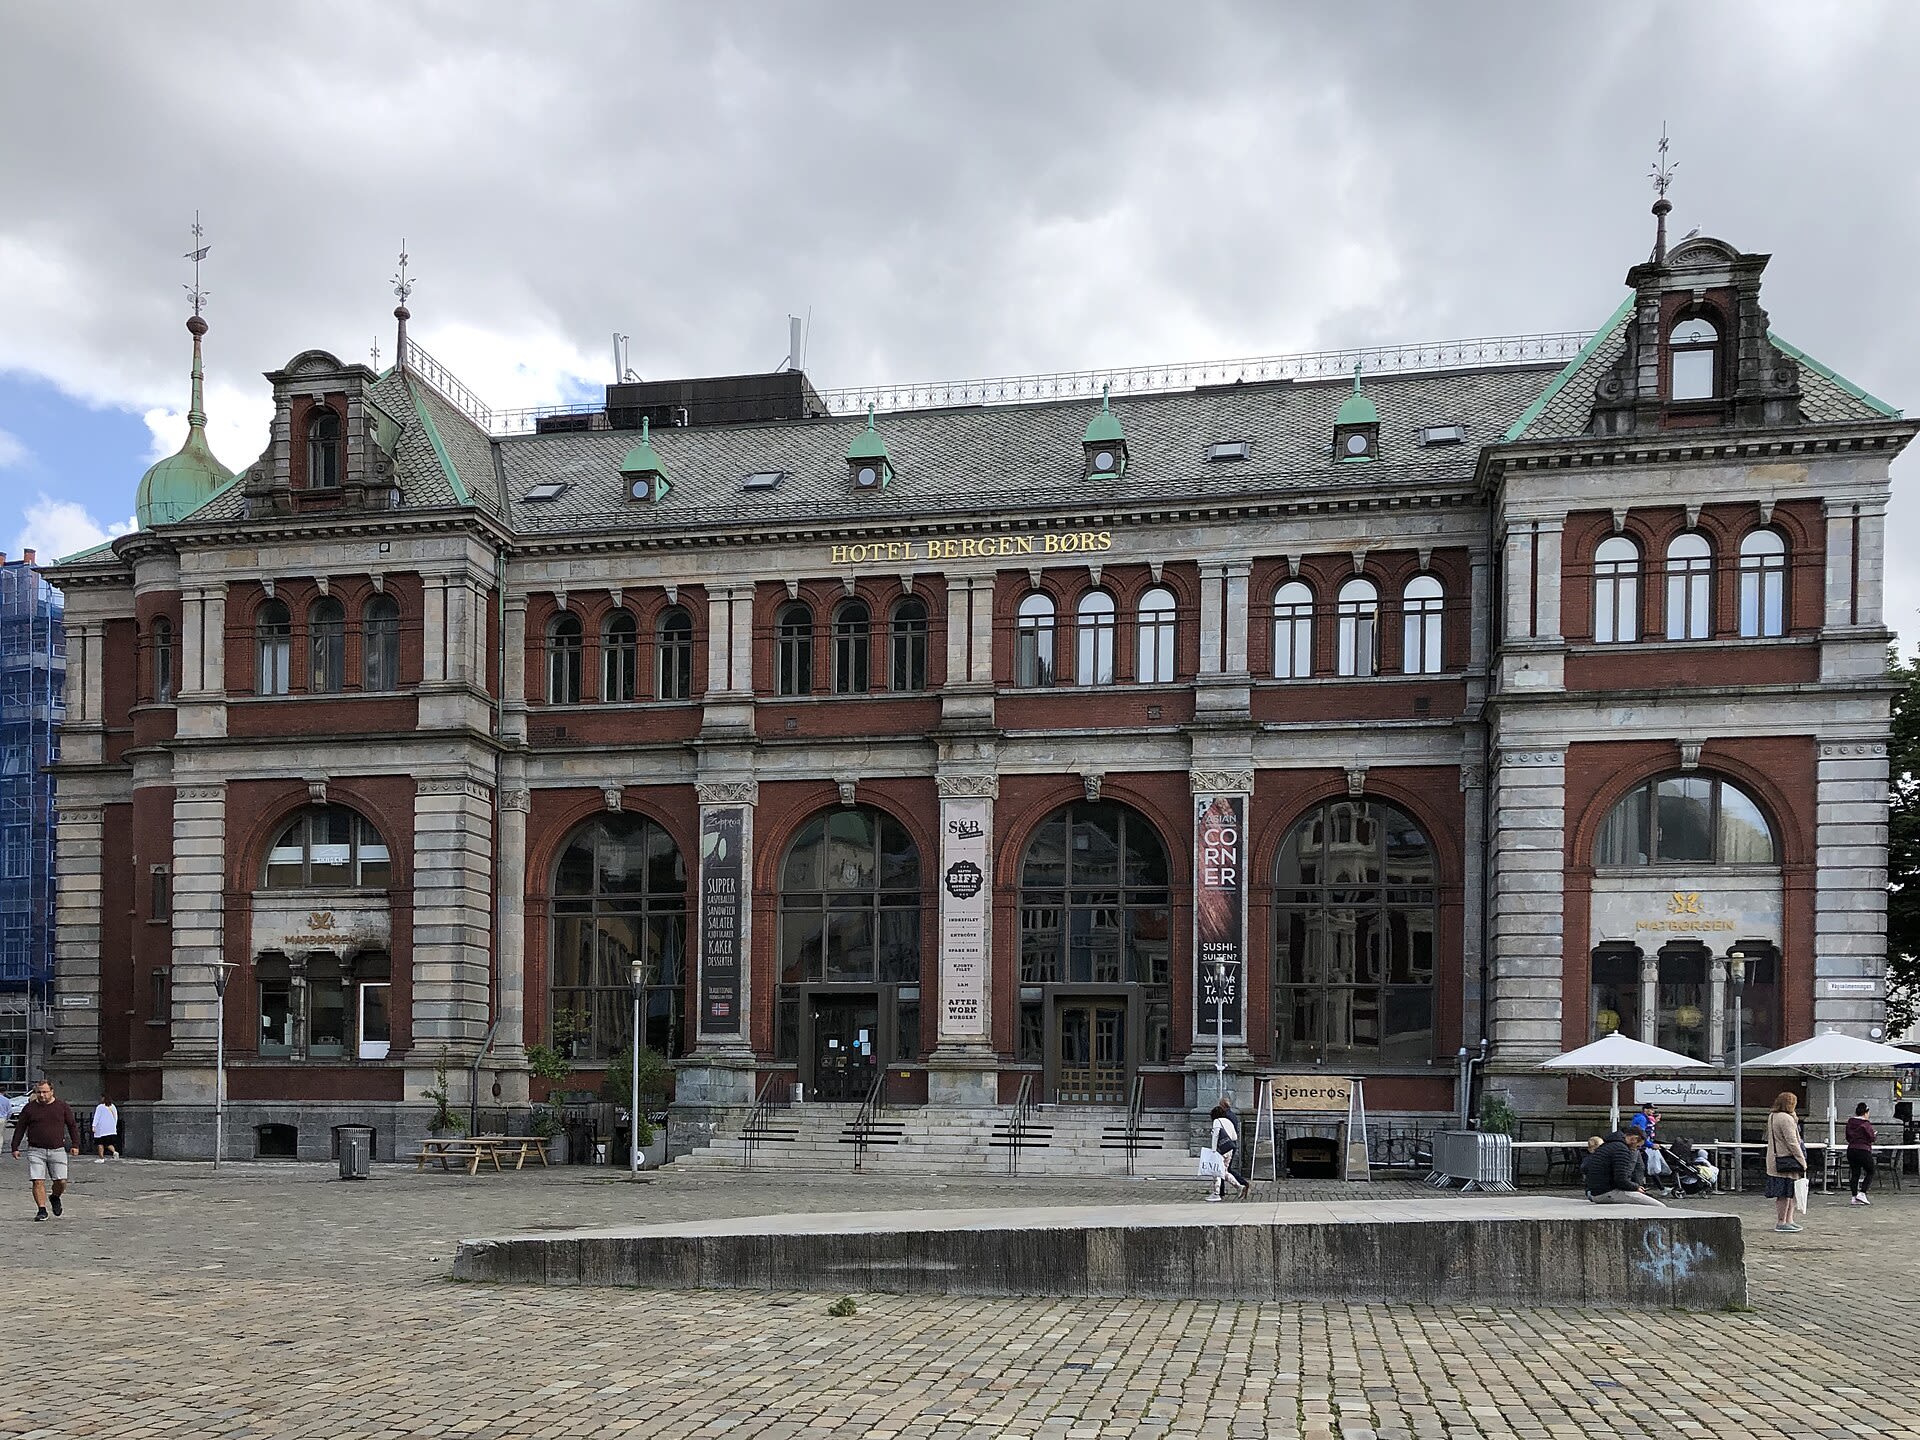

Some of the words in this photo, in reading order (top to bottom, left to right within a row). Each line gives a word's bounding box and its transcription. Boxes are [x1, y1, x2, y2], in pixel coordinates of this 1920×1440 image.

[831, 542, 918, 564] HOTEL
[927, 535, 1033, 560] BERGEN
[1044, 532, 1112, 553] BØRS
[1206, 814, 1236, 823] ASIAN
[1204, 828, 1237, 846] CO
[1204, 847, 1237, 865] RN
[949, 874, 980, 884] BIFF
[1204, 867, 1236, 885] ER
[707, 877, 736, 894] SUPPER
[706, 905, 736, 916] SANDWICH
[708, 916, 734, 929] SALATER
[708, 940, 733, 954] KAKER
[1203, 943, 1238, 951] SUSHI-
[1204, 996, 1235, 1004] AWAY
